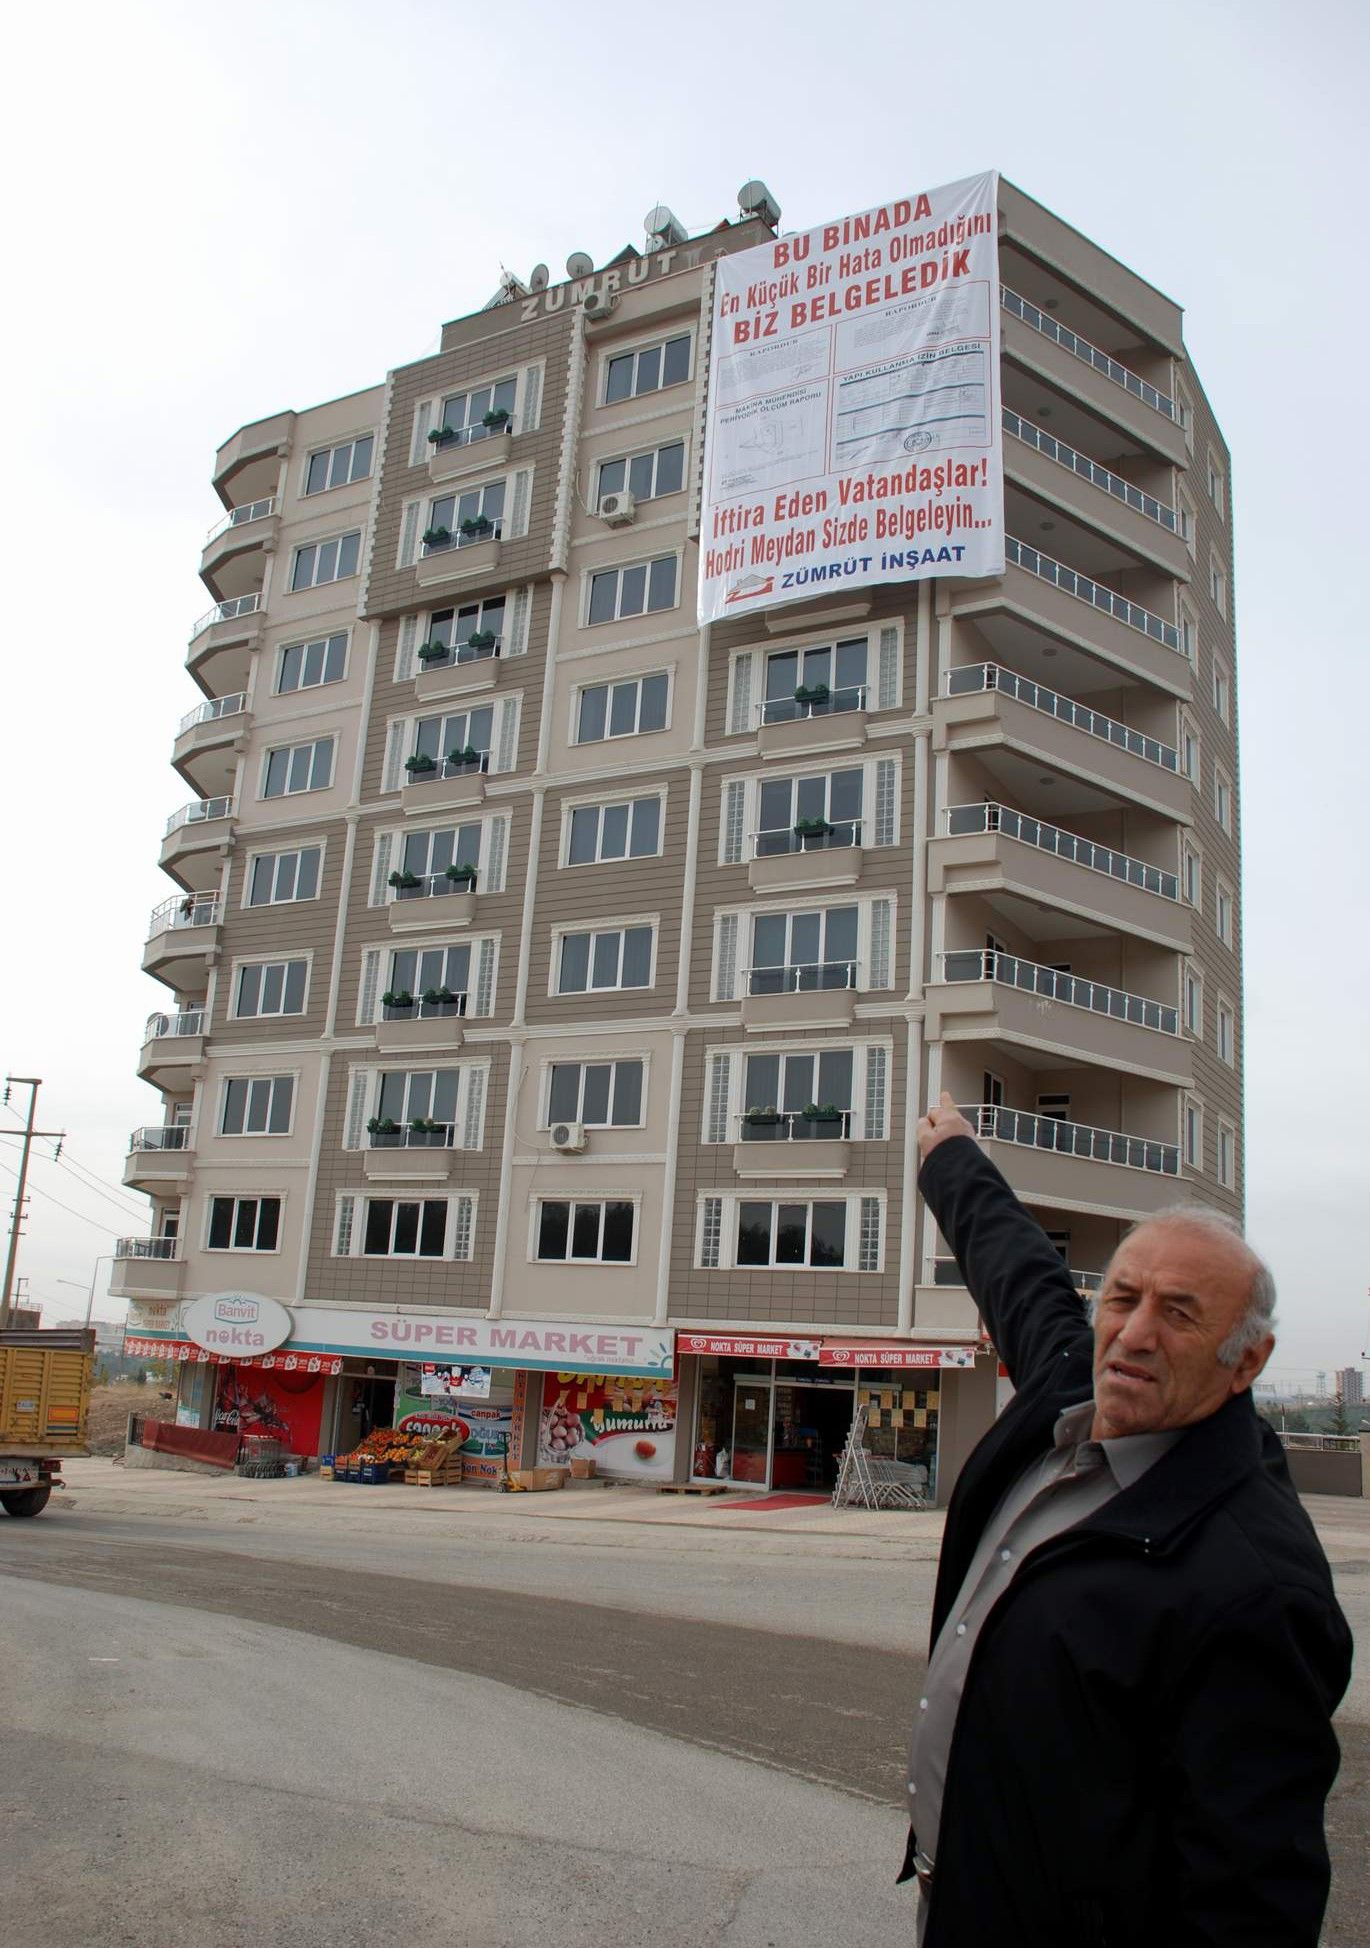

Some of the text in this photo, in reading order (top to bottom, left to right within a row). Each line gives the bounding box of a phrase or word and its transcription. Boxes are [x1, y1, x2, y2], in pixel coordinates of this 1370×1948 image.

[773, 193, 932, 269] BU BİNADA
[720, 213, 992, 318] En Küçük Bir Hata Olmadığını
[733, 249, 971, 345] BİZ BELGELEDİK
[712, 457, 988, 539] İftira Eden Vatandaşlar!
[705, 495, 992, 580] Hodri Meydan Sizde Belgeleyin...
[781, 545, 966, 589] ZÜMRÜT İNŞAAT
[218, 1304, 257, 1319] Banvit
[206, 1327, 265, 1347] nokta
[370, 1318, 644, 1357] SÜPER MARKET
[710, 1341, 784, 1356] NOKTA SÜPER MARKET
[854, 1352, 934, 1365] NOKTA SÜPER MARKET
